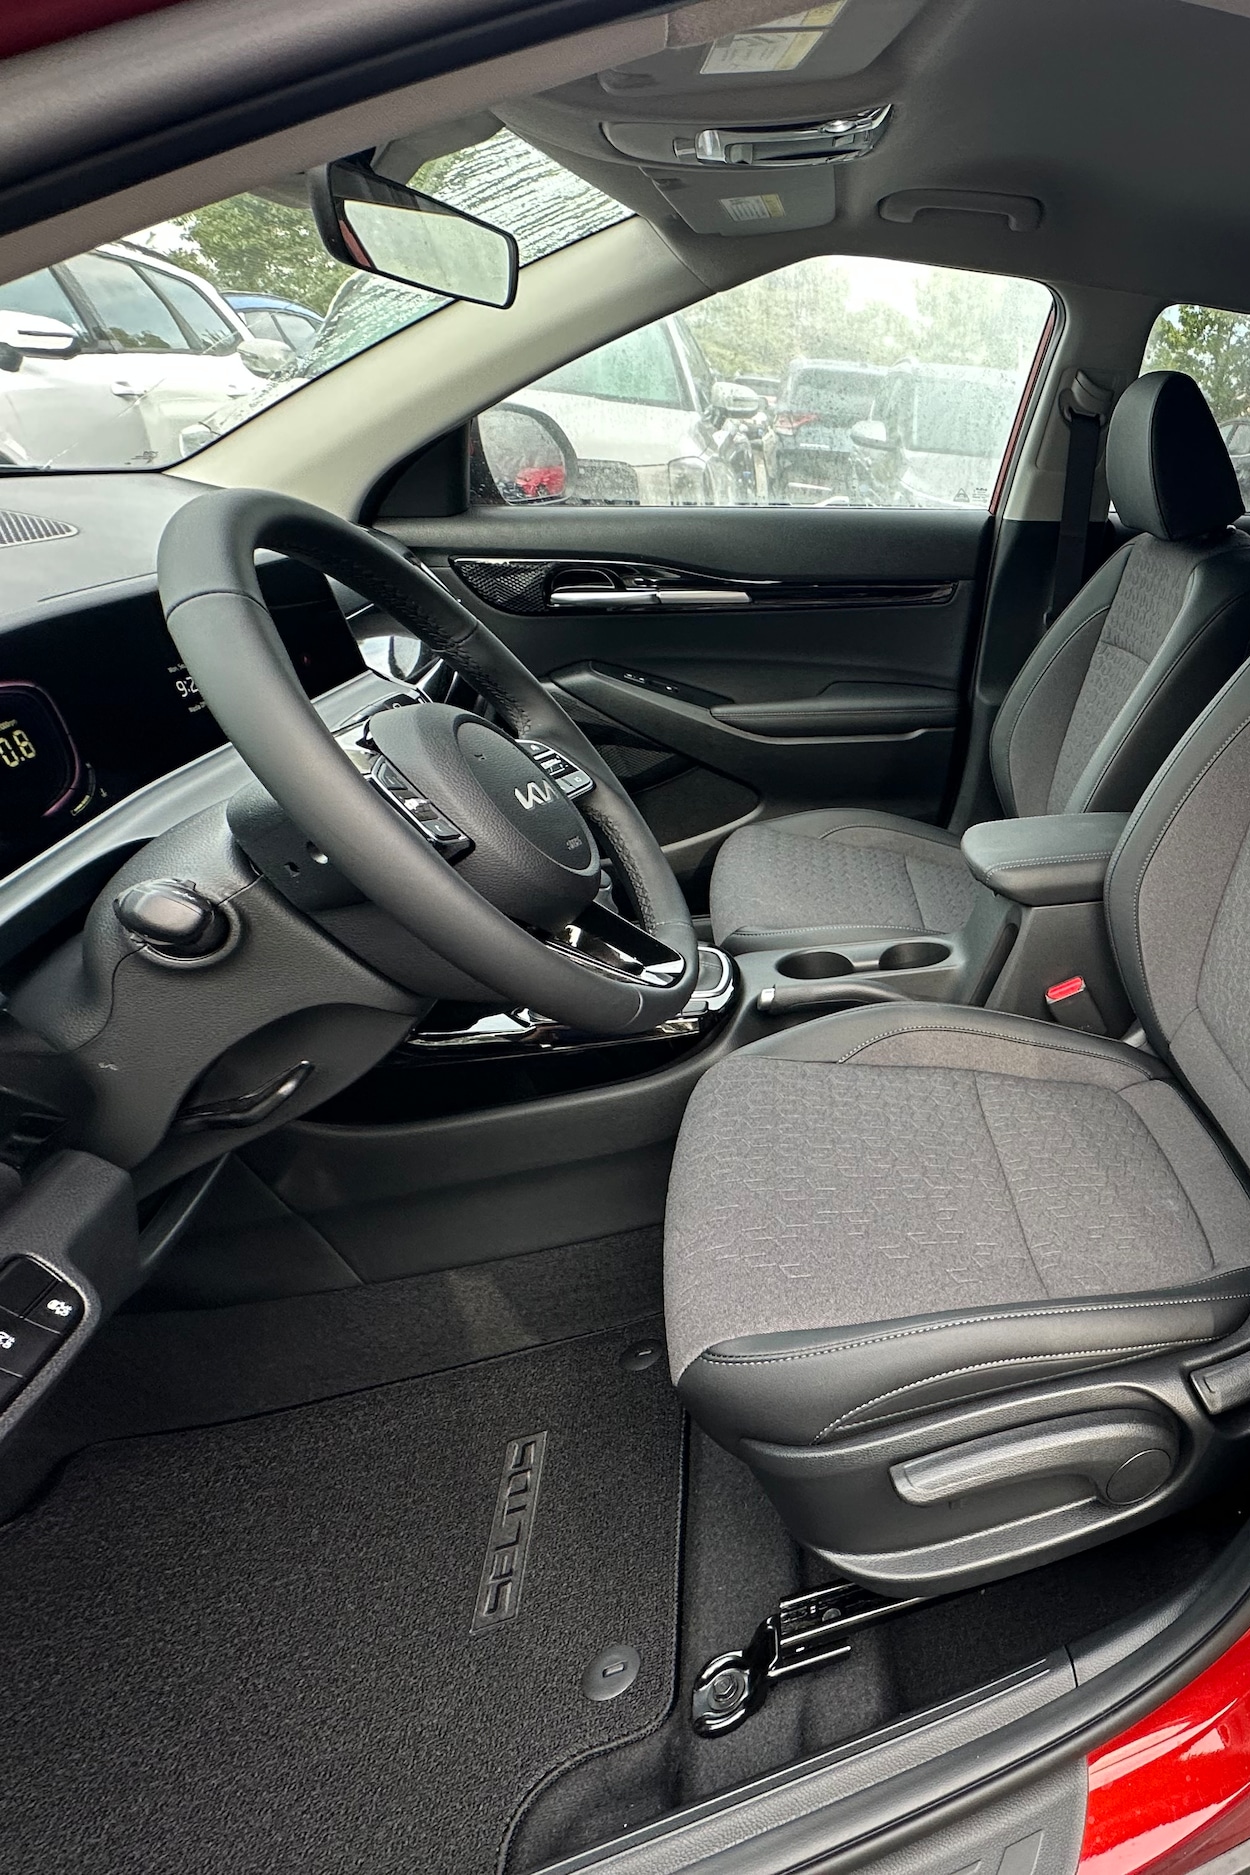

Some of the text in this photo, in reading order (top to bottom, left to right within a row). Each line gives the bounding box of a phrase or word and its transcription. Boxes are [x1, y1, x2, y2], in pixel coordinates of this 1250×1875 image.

[176, 676, 198, 697] 9:2
[514, 779, 559, 810] KIA
[482, 1440, 537, 1616] SELTOS
